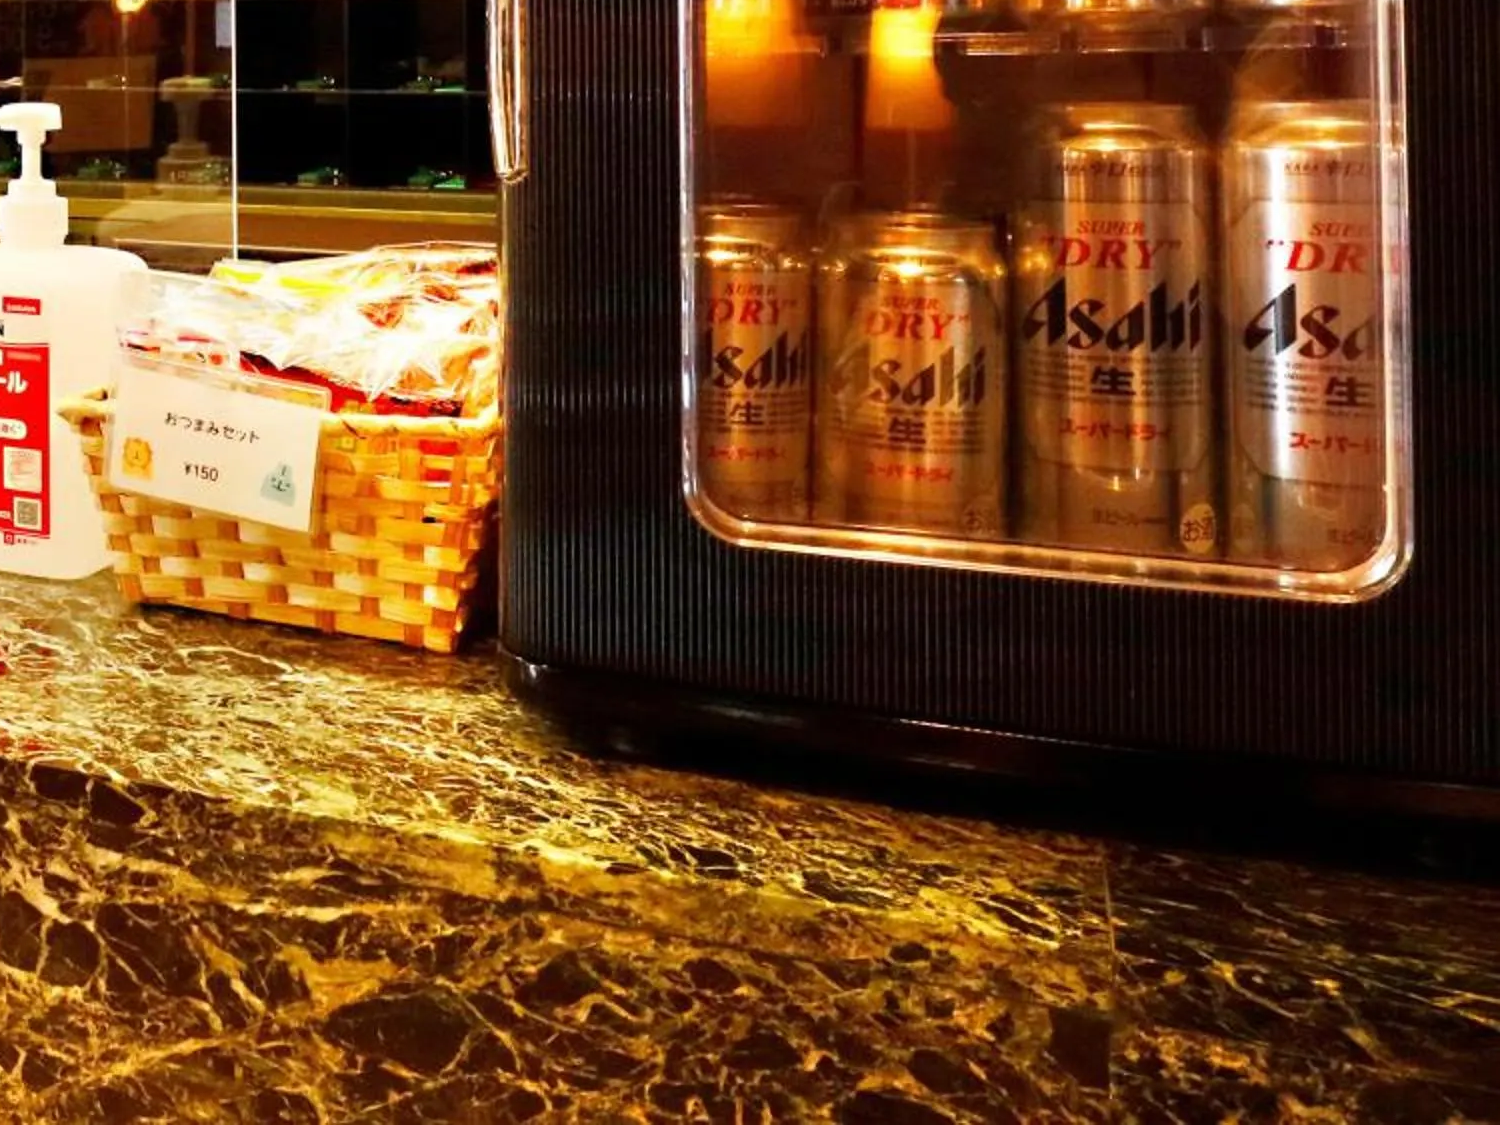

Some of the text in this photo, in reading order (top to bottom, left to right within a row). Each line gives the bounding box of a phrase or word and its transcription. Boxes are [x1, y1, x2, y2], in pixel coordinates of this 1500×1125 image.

[1077, 219, 1146, 237] SUPER
[1021, 277, 1200, 352] Asahi
[1091, 366, 1136, 396] 生
[1325, 376, 1376, 408] 生
[164, 411, 261, 444] おつまみセット
[730, 401, 765, 425] 生
[887, 415, 927, 444] 生
[184, 461, 220, 482] ¥150
